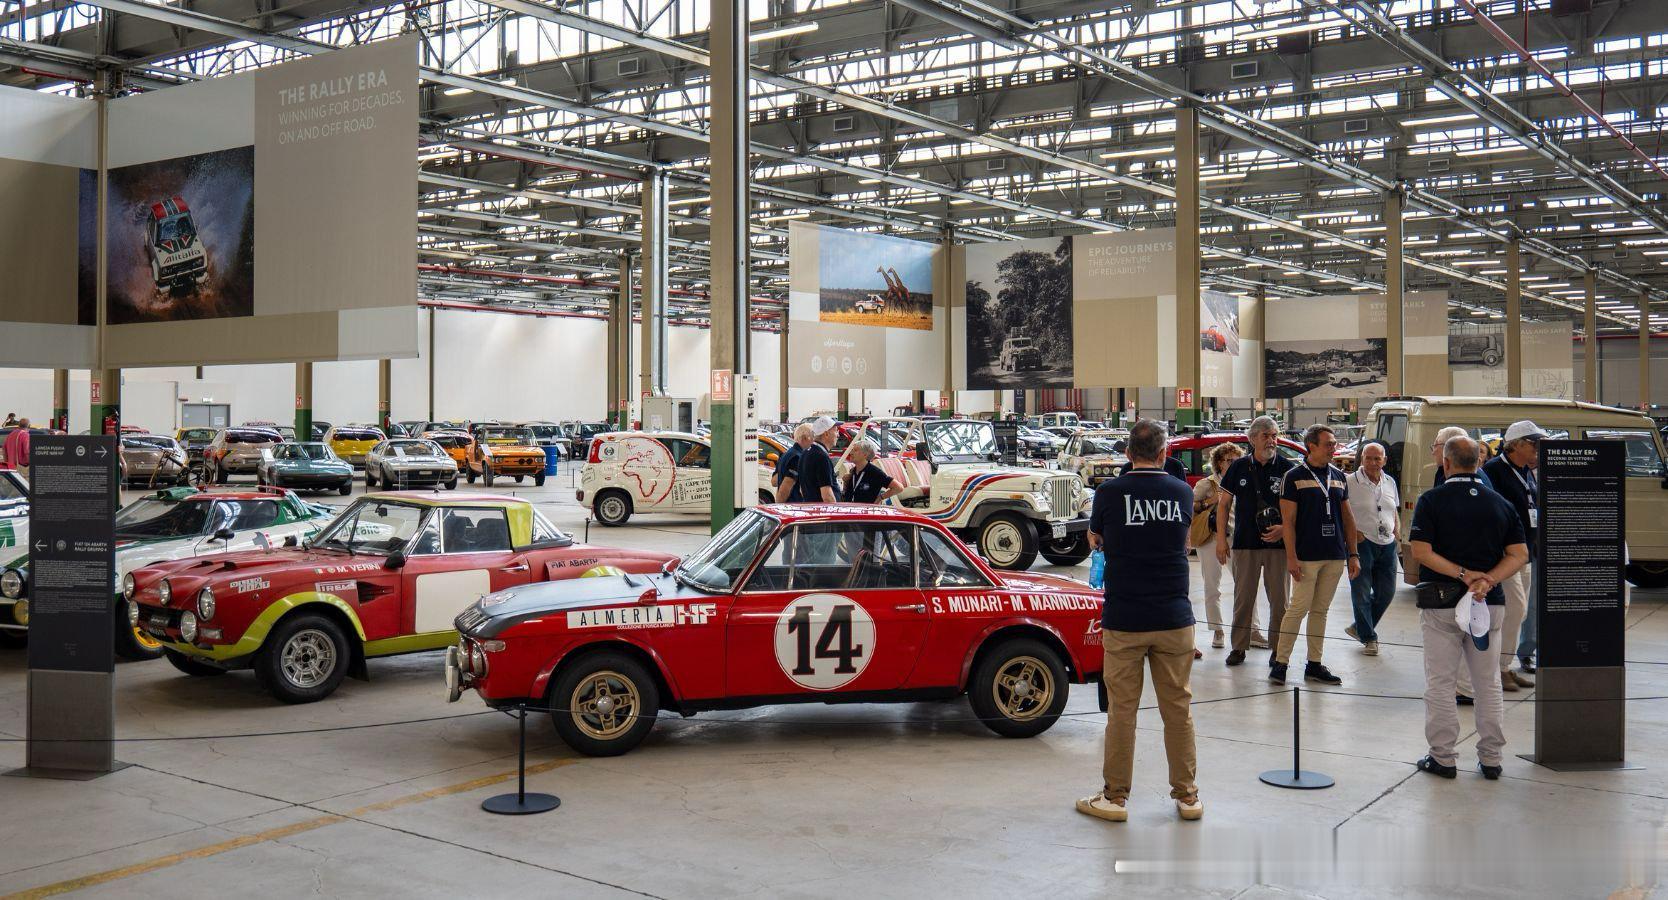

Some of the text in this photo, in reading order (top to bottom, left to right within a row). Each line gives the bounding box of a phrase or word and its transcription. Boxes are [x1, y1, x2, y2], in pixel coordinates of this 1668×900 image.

[279, 70, 388, 106] THE RALLY ERA
[279, 90, 404, 125] WINNING FOR DECADES,
[279, 116, 376, 144] ON AND OFF ROAD.
[164, 250, 200, 264] Alitalia
[1088, 242, 1173, 256] EPIC JOURNEYS
[1088, 256, 1152, 266] THE ADVENTURE
[1124, 494, 1182, 526] LANCIA
[552, 558, 598, 568] FIAT ABARTH
[580, 603, 716, 626] ALMERIA HF
[932, 596, 945, 614] S.
[950, 595, 1002, 614] MUNARI
[1012, 596, 1027, 612] M.
[1030, 594, 1098, 612] MANNUCCI
[787, 604, 863, 676] 14
